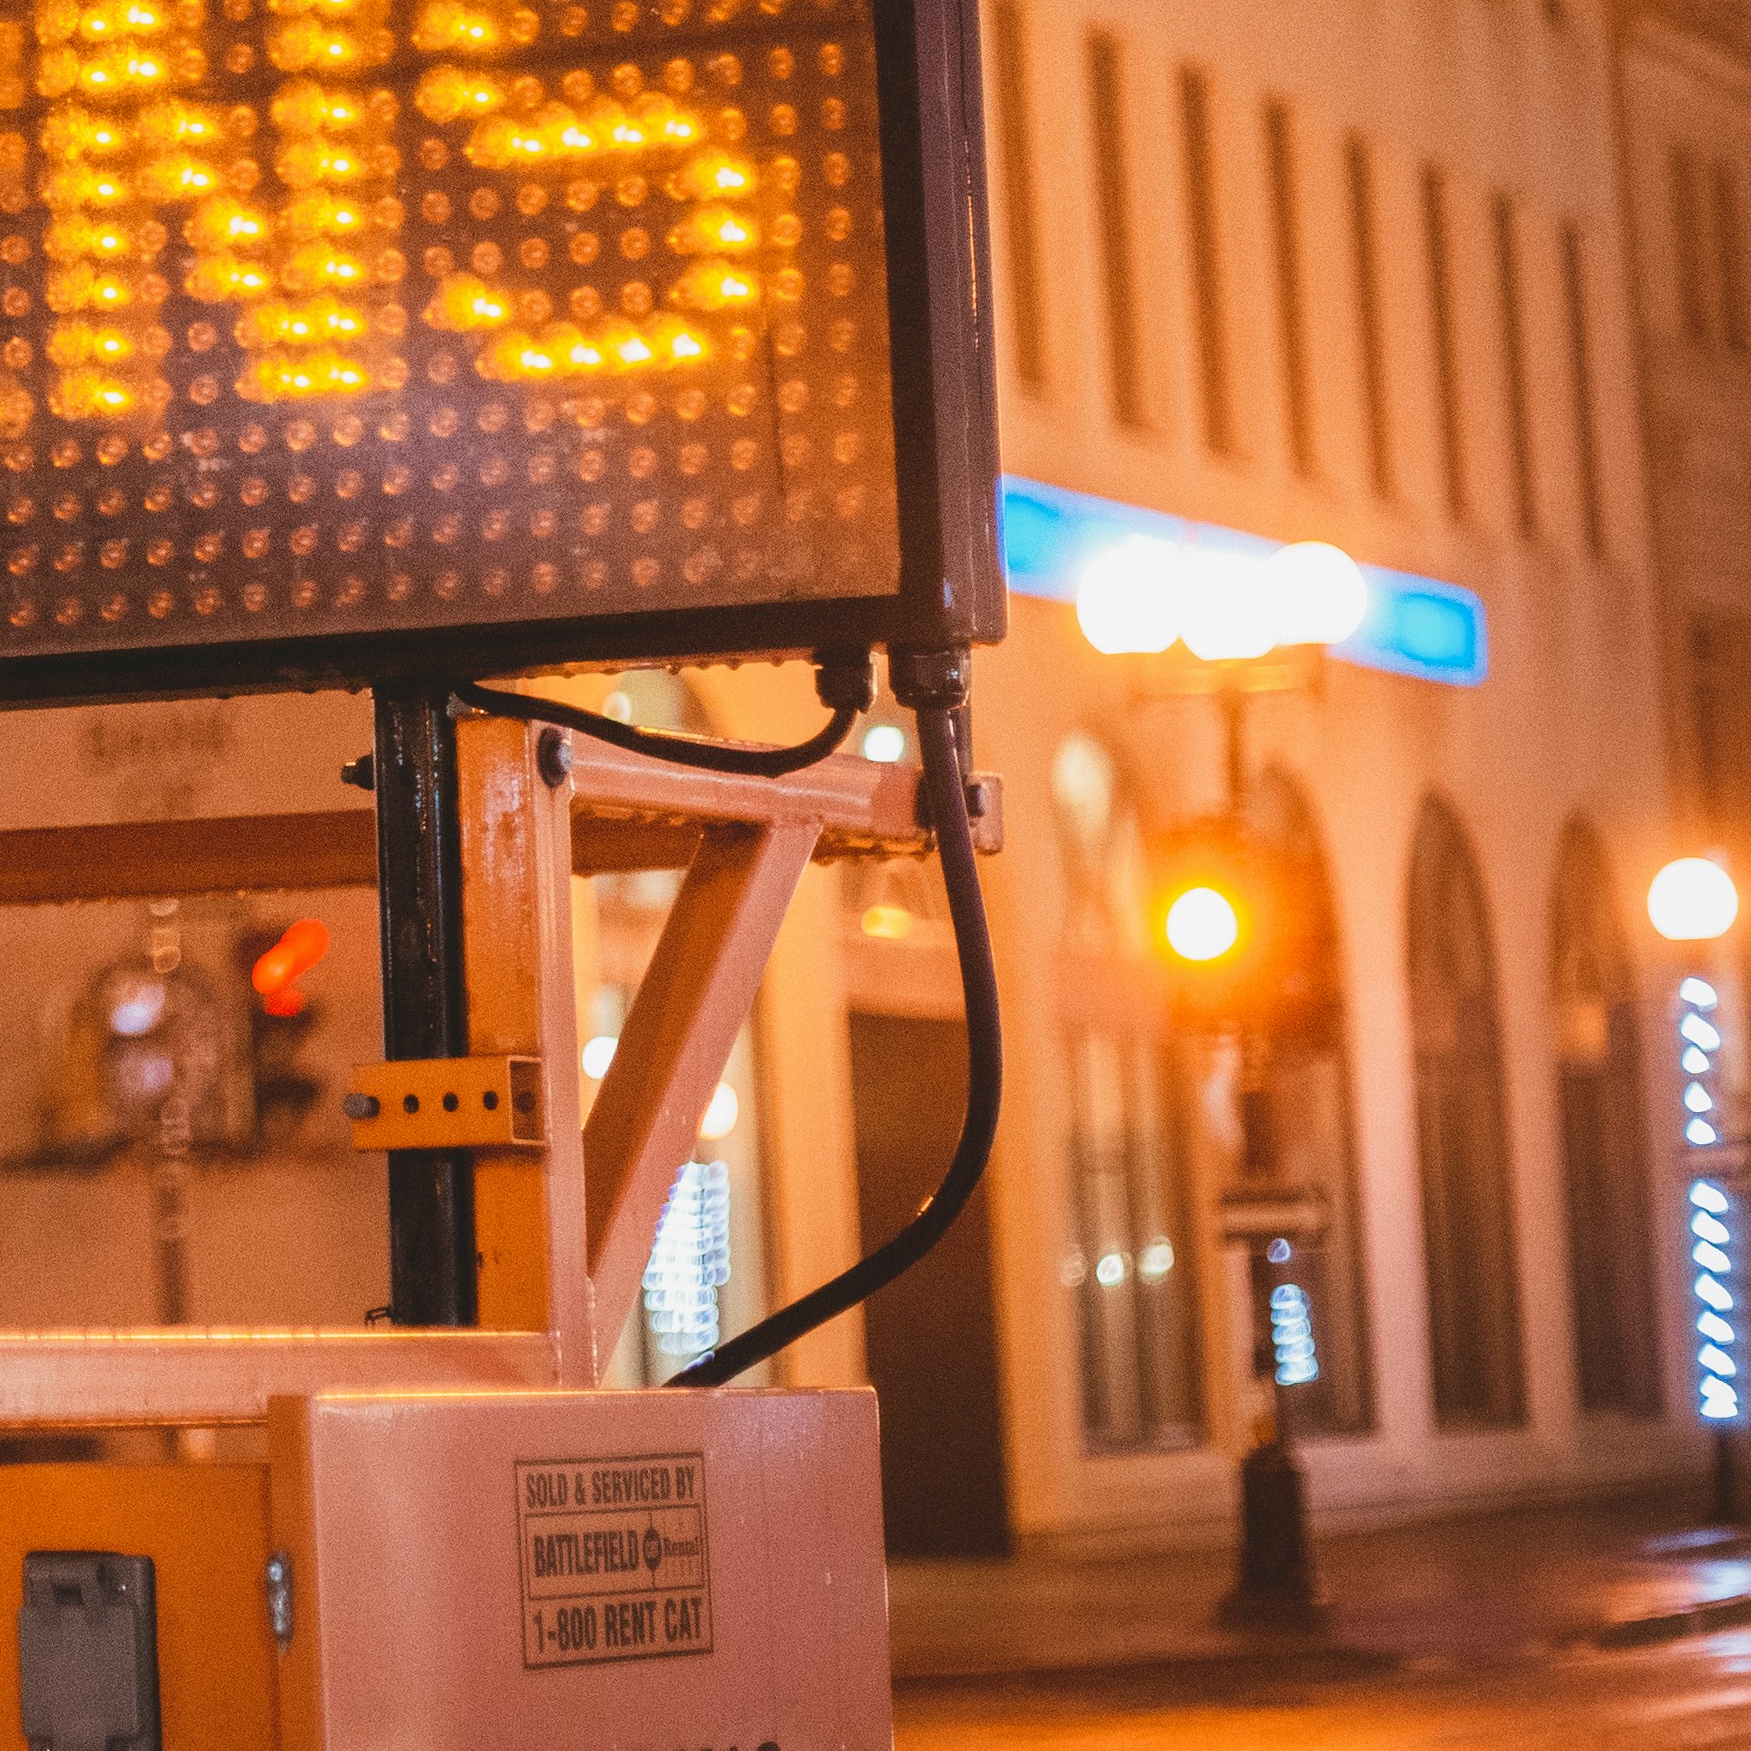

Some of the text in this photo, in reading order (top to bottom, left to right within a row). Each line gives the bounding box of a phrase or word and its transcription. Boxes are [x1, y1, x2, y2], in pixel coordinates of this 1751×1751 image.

[526, 1465, 695, 1508] SOLD & SERVICED BY
[533, 1529, 639, 1578] BATTLEFIELD
[533, 1596, 701, 1653] 1-800 RENT CAT
